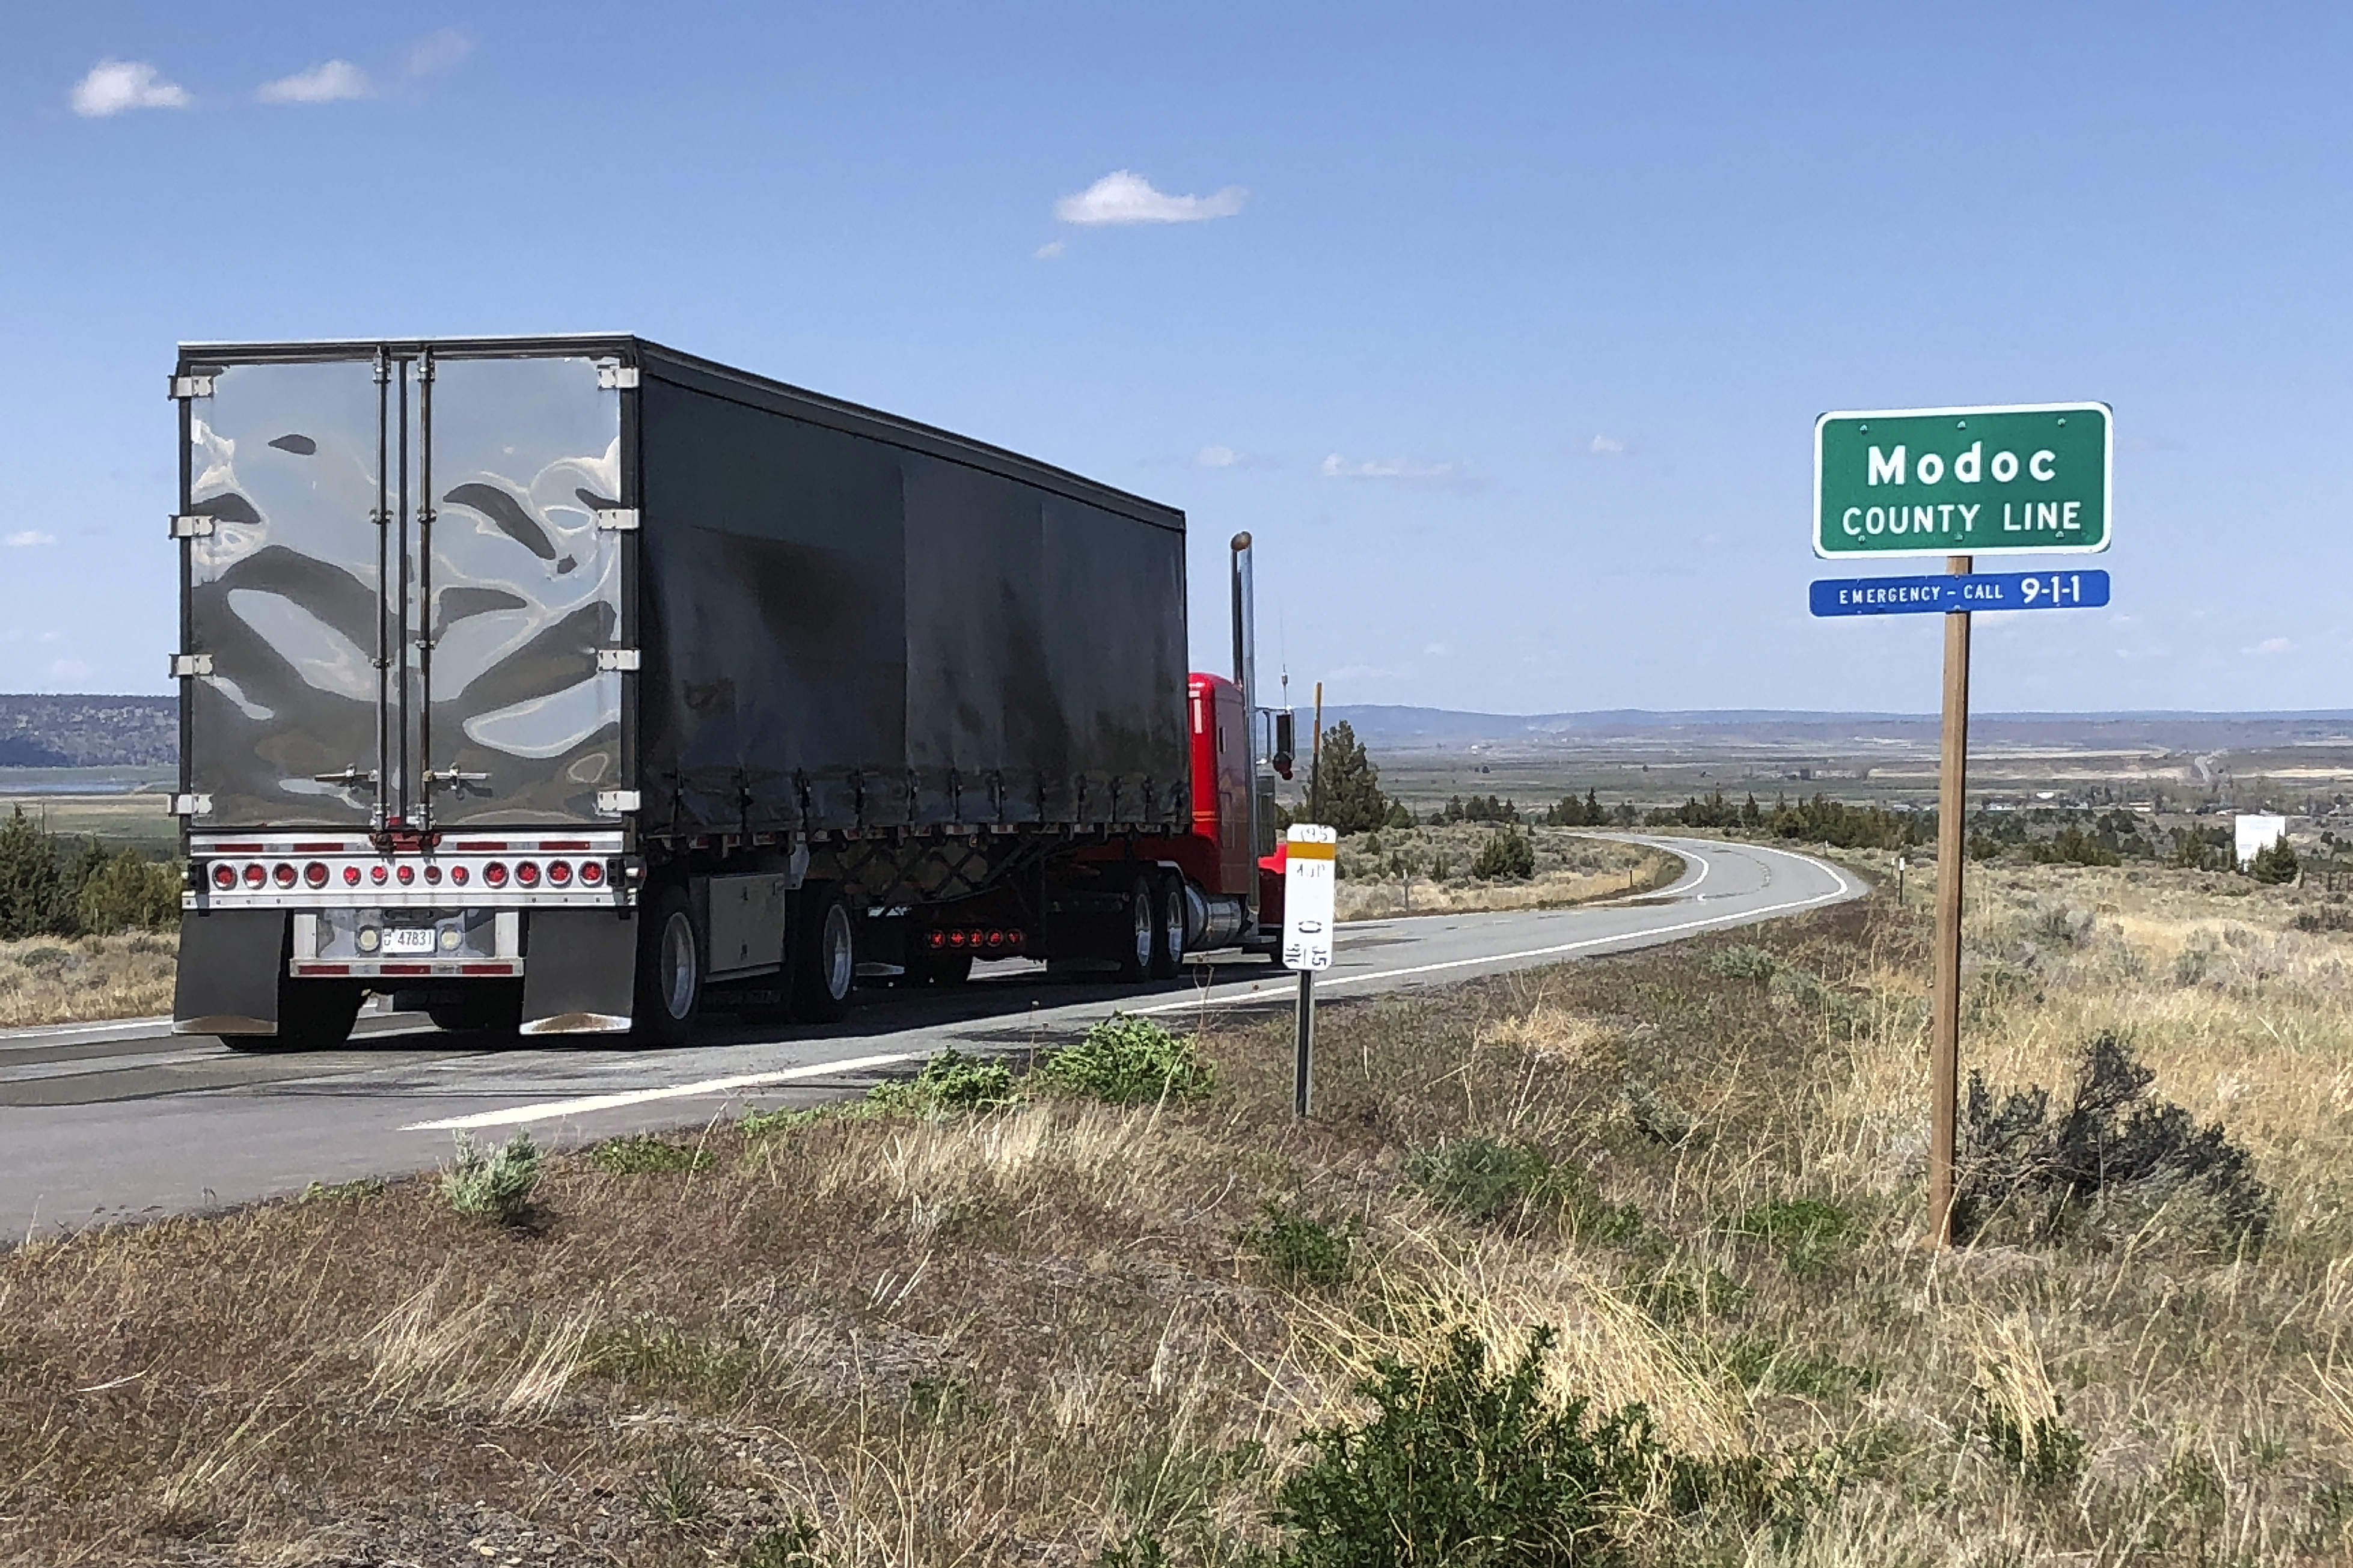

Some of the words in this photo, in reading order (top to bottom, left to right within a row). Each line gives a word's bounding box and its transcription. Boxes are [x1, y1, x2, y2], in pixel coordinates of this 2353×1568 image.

[1868, 441, 2056, 486] Modoc
[1843, 504, 1981, 535] COUNTY
[2003, 501, 2081, 531] LINE
[1840, 585, 1941, 605] EMERGENCY
[1963, 584, 2004, 599] CALL
[2021, 575, 2080, 603] 9-1-1
